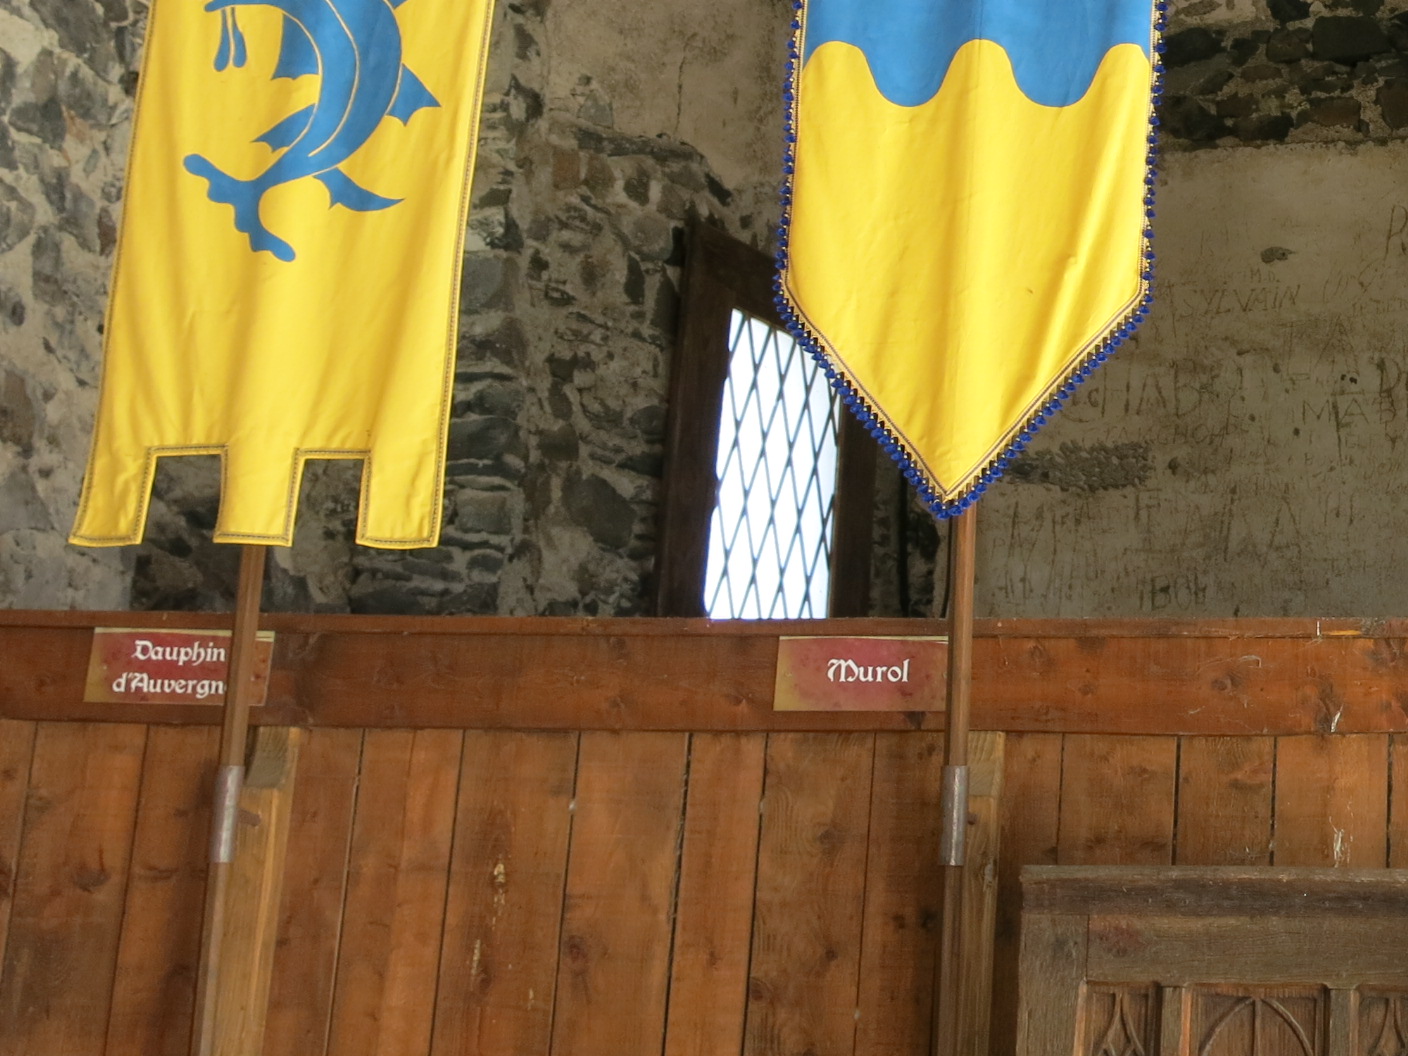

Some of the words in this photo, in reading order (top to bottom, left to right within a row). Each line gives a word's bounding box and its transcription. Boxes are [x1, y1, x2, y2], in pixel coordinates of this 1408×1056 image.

[1183, 284, 1301, 319] SYLVAIN
[131, 639, 226, 666] Dauphin
[826, 658, 911, 683] Murol
[111, 672, 227, 699] d'Auvergn
